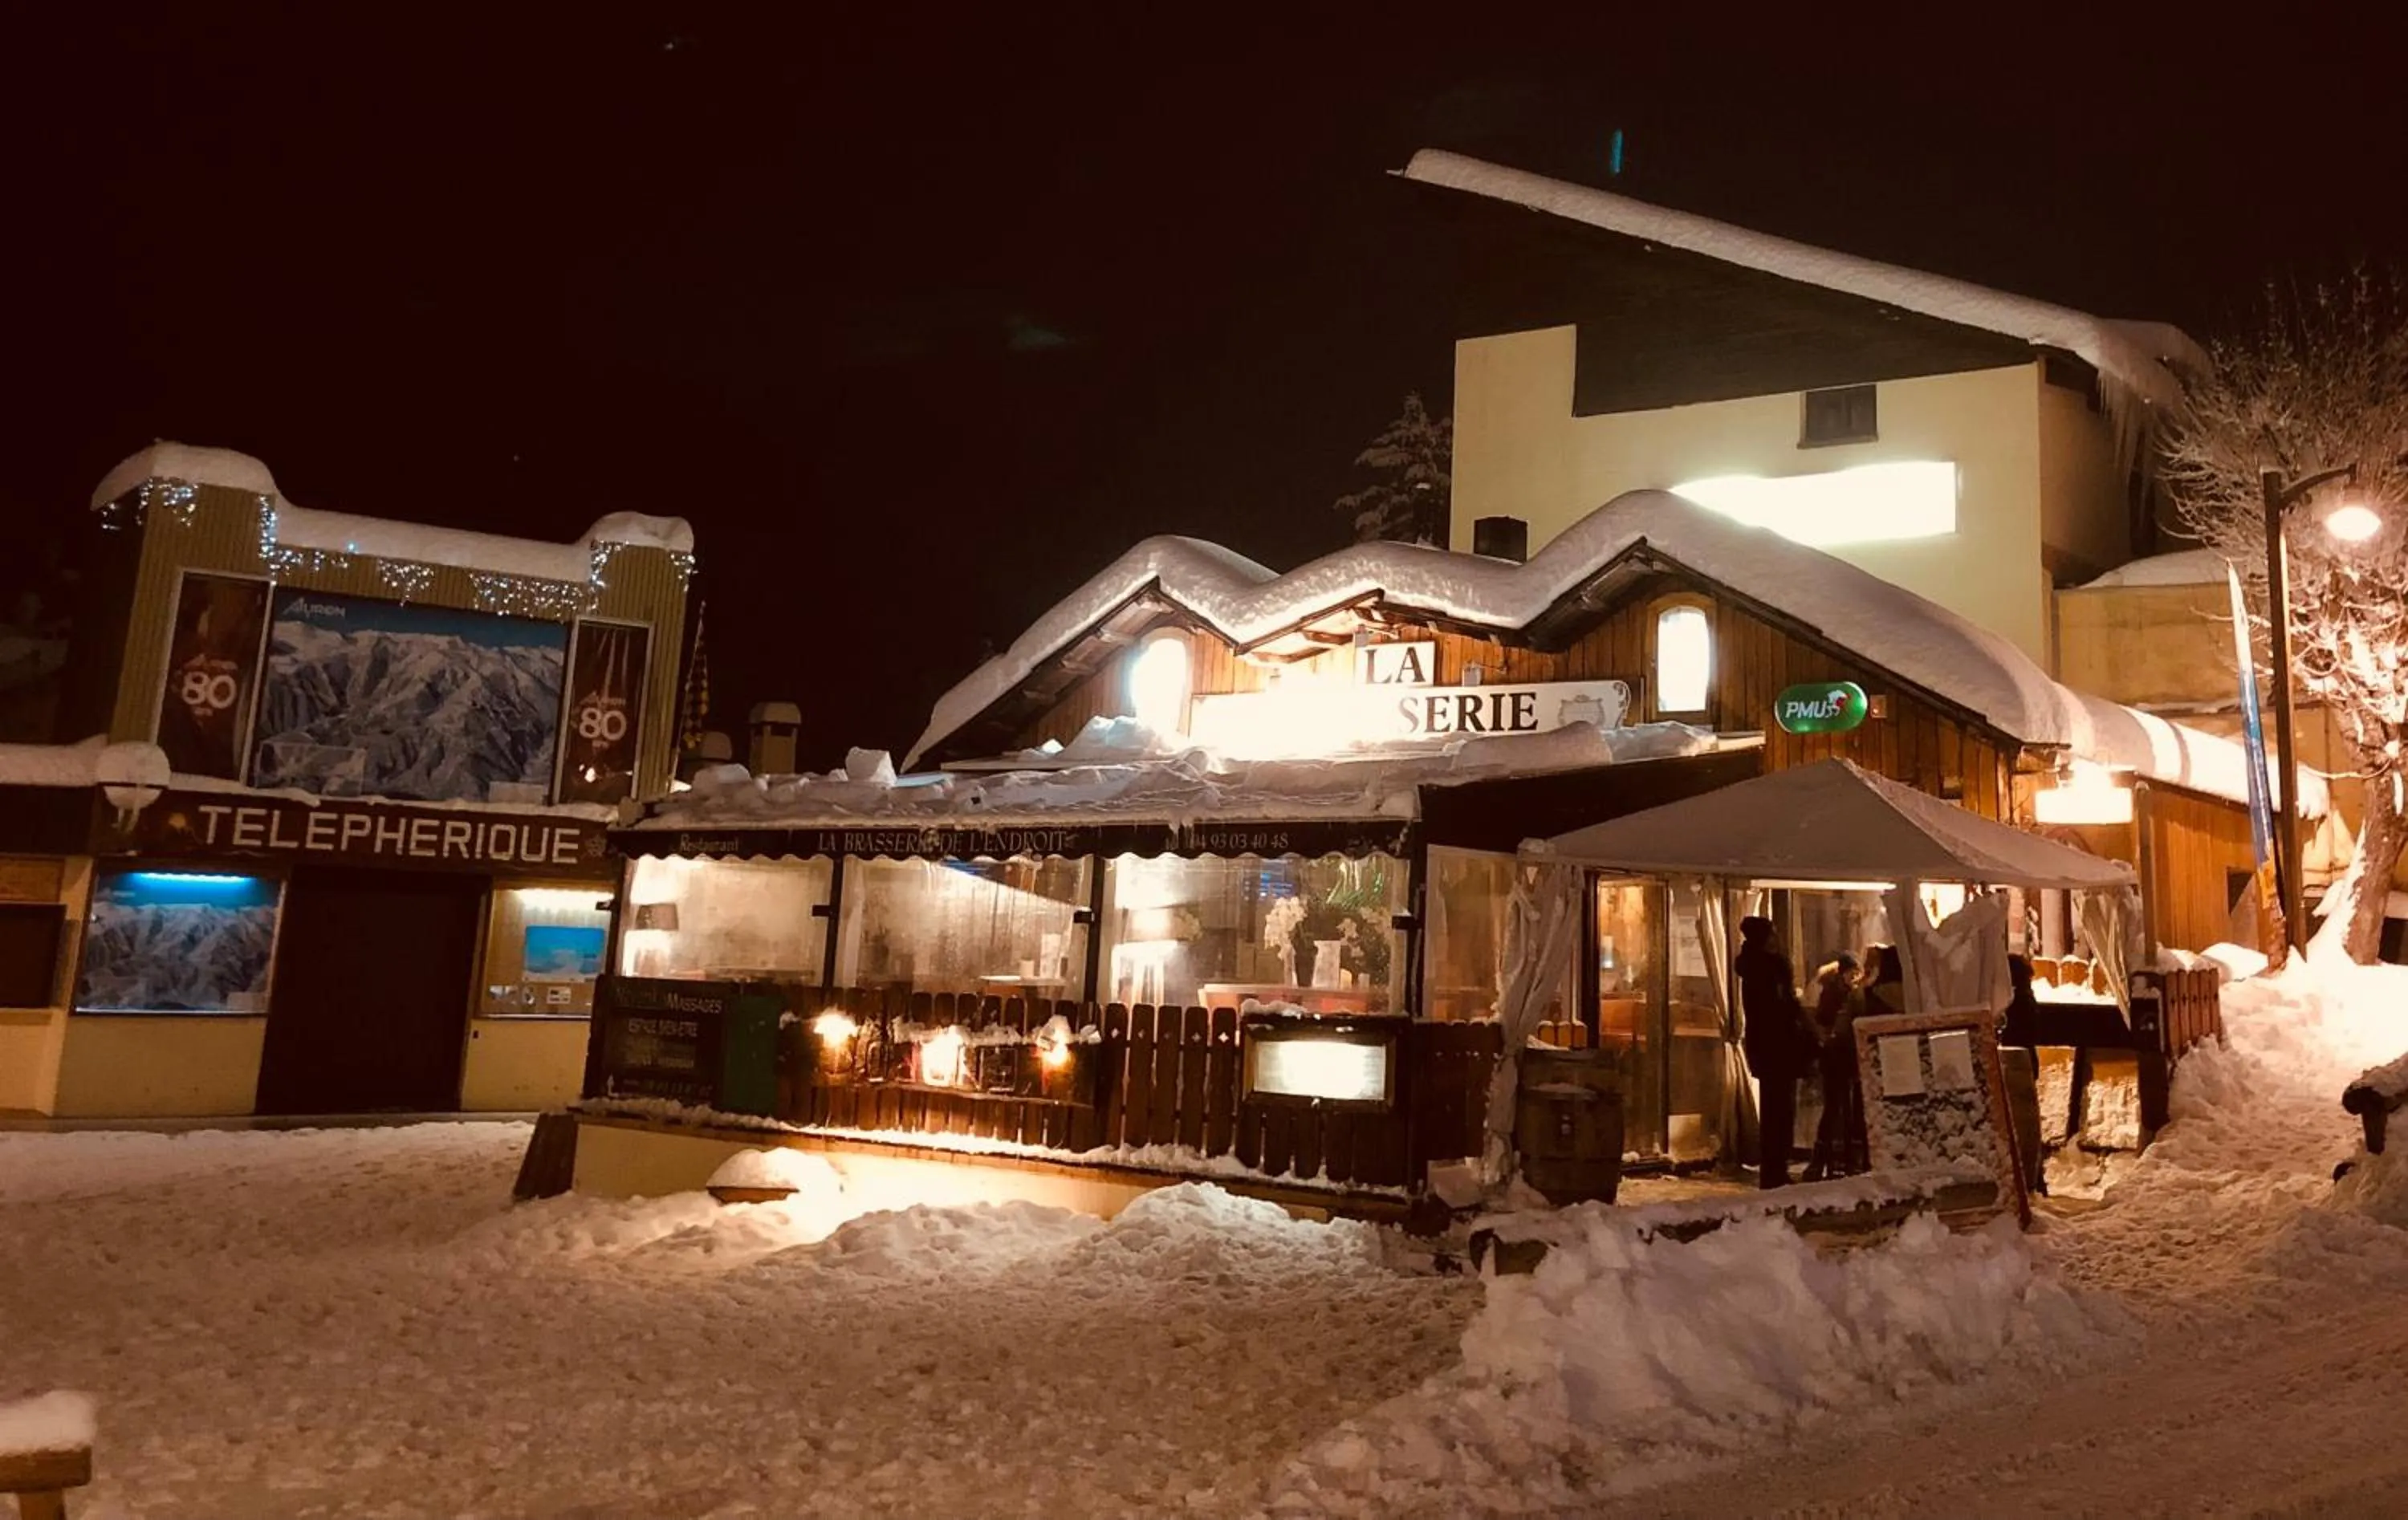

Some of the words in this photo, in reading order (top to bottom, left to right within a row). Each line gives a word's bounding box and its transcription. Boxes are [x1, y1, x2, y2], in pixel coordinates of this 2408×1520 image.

[1365, 645, 1426, 684] LA
[181, 671, 238, 709] 80
[579, 707, 627, 742] 80
[1784, 700, 1828, 718] PMU
[198, 806, 581, 864] TELEPHERIQUE
[817, 833, 836, 851] LA
[939, 831, 962, 852] DE
[969, 830, 1067, 852] L'ENDROIT
[1210, 831, 1227, 849] 93
[1229, 831, 1247, 850] 03
